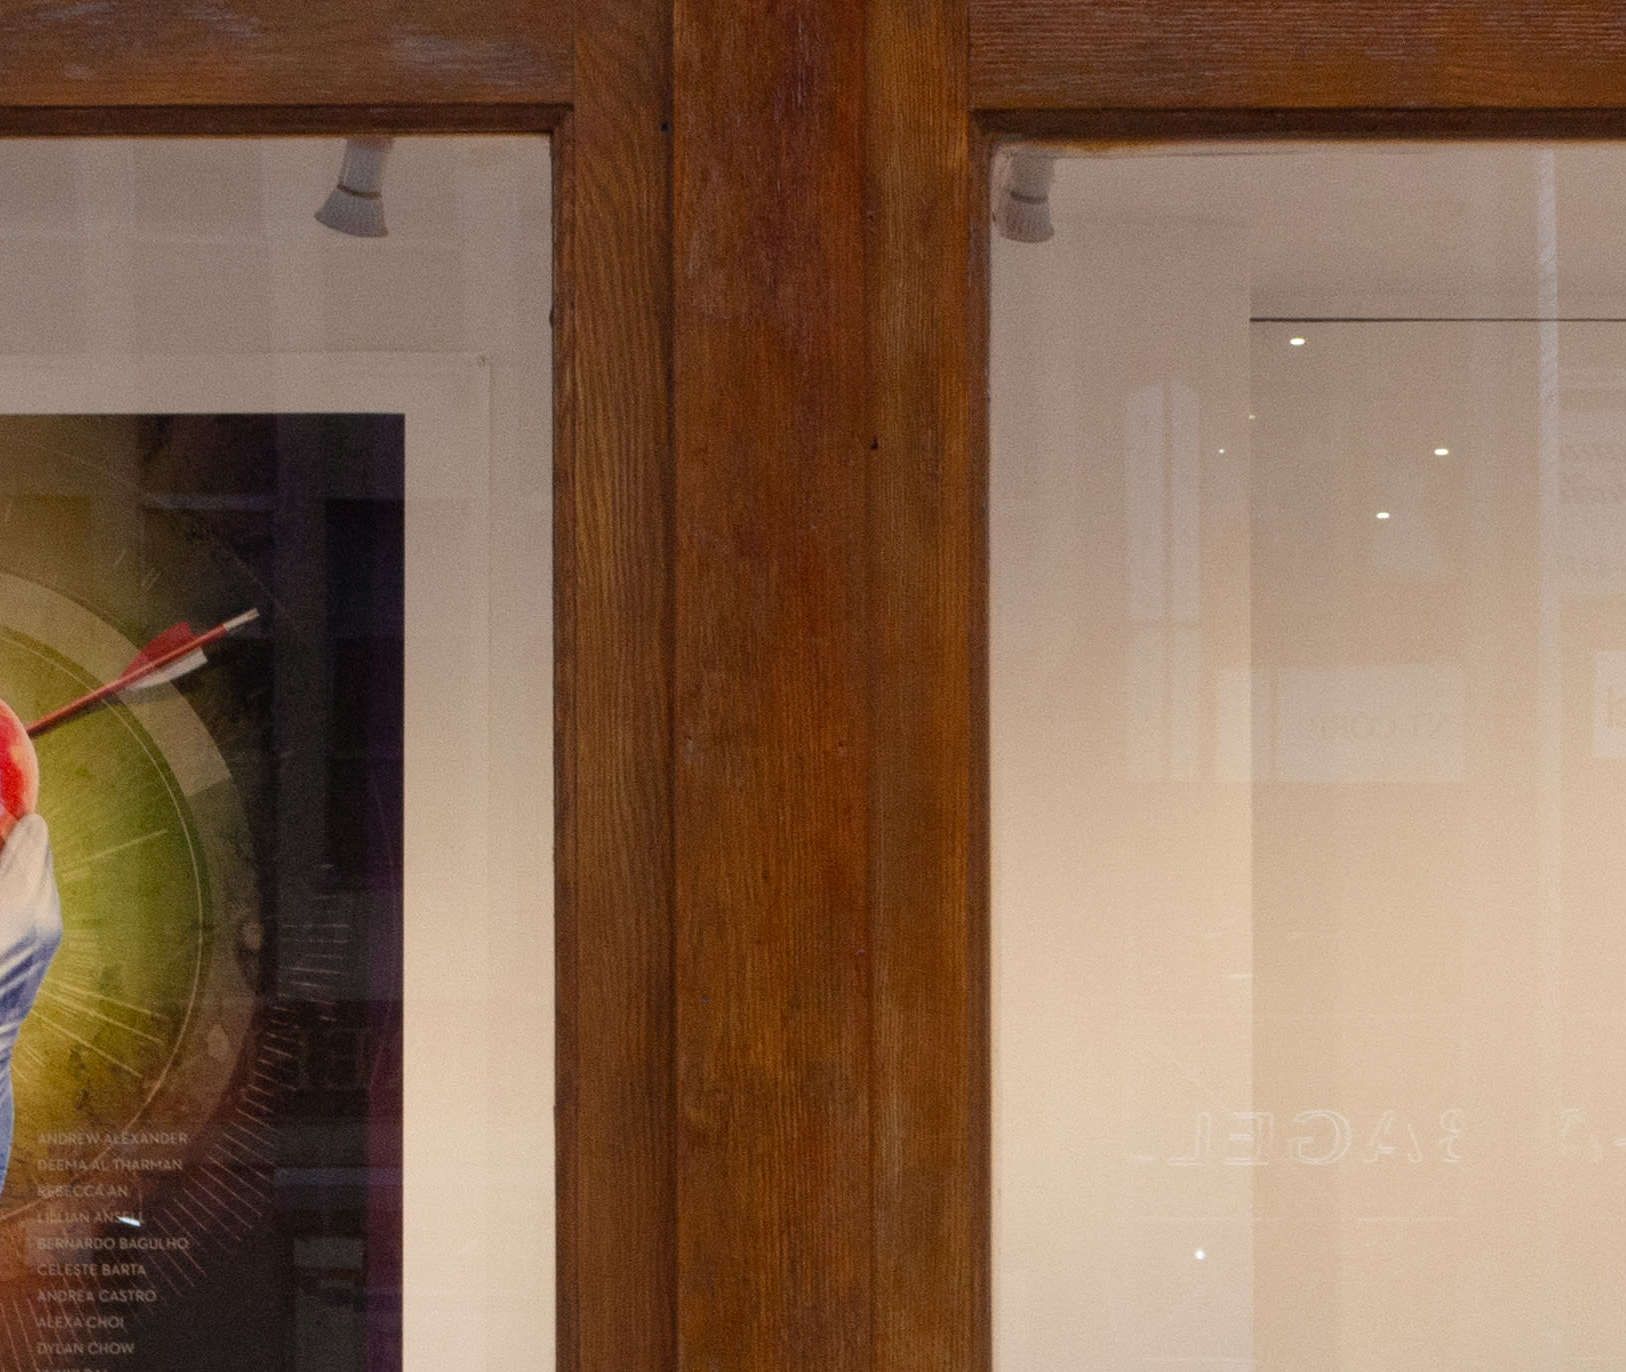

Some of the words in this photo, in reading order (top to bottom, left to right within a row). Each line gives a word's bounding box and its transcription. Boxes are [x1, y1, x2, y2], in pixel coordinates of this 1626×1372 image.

[37, 1133, 102, 1145] ANDREW
[105, 1133, 189, 1145] ALEXANDER
[37, 1159, 87, 1171] DEEMA
[93, 1159, 108, 1171] AL
[37, 1185, 104, 1197] REBECCA
[107, 1185, 128, 1197] AN
[37, 1238, 115, 1250] BERNARDO
[119, 1238, 189, 1250] BAGULHO
[37, 1264, 98, 1275] CELESTE
[102, 1264, 146, 1275] BARTA
[37, 1290, 95, 1303] ANDREA
[99, 1290, 157, 1303] CASTRO
[37, 1316, 83, 1328] ALEXA
[86, 1316, 125, 1328] CHOI
[37, 1342, 84, 1355] DYLAN
[88, 1342, 134, 1355] CHOW
